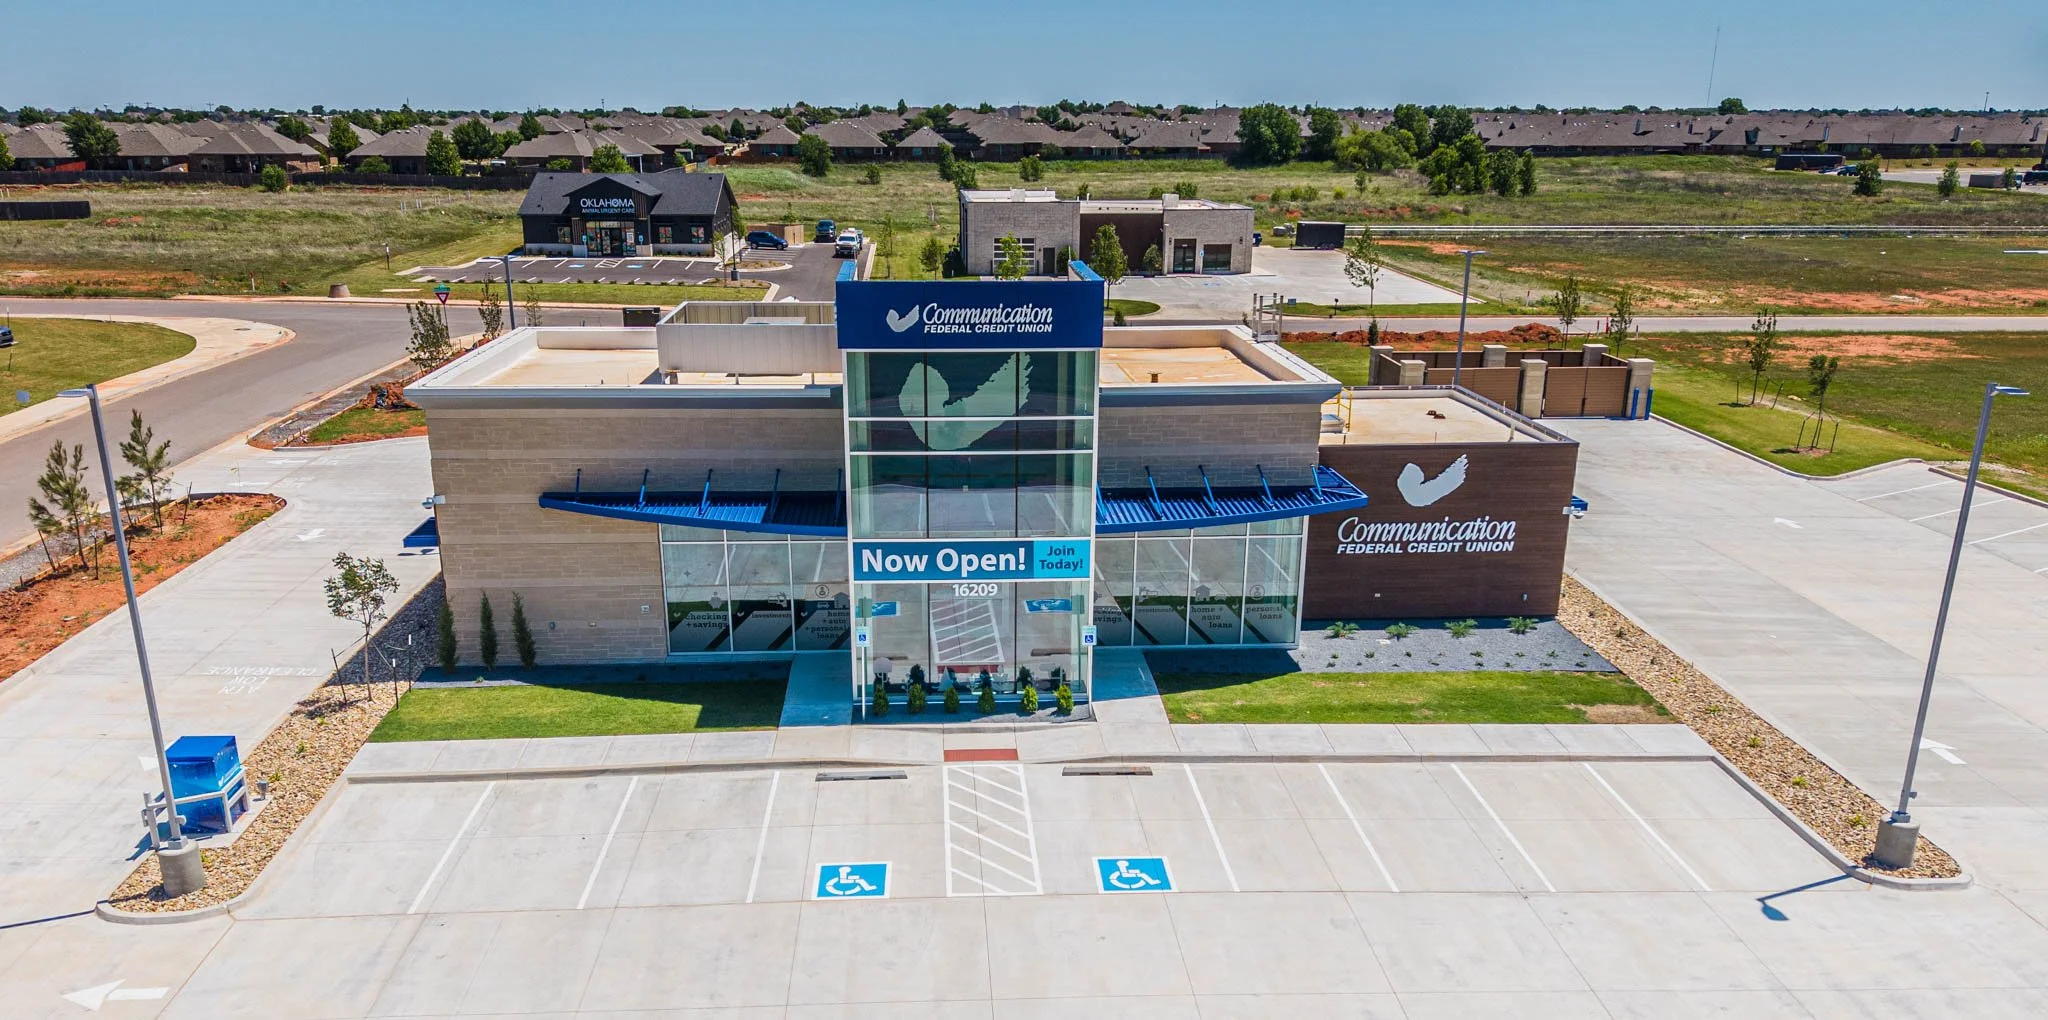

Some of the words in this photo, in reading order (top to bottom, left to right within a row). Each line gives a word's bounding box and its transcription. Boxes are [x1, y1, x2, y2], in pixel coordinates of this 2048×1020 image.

[580, 198, 635, 208] OKLAHOMA
[923, 303, 1053, 324] Communication
[924, 325, 972, 333] FEDERAL
[975, 325, 1014, 333] CREDIT
[1017, 324, 1052, 333] UNION
[1337, 516, 1516, 542] Communication
[1047, 545, 1075, 556] Join
[1337, 543, 1403, 554] FEDERAL
[1407, 542, 1463, 553] CREDIT
[1466, 541, 1515, 552] UNION
[861, 548, 928, 573] Now
[936, 547, 1026, 577] Open!
[1039, 558, 1084, 572] Today!
[952, 583, 998, 597] 16209
[1246, 605, 1283, 613] personal
[686, 612, 728, 621] checking
[208, 666, 317, 676] CLEARANCE
